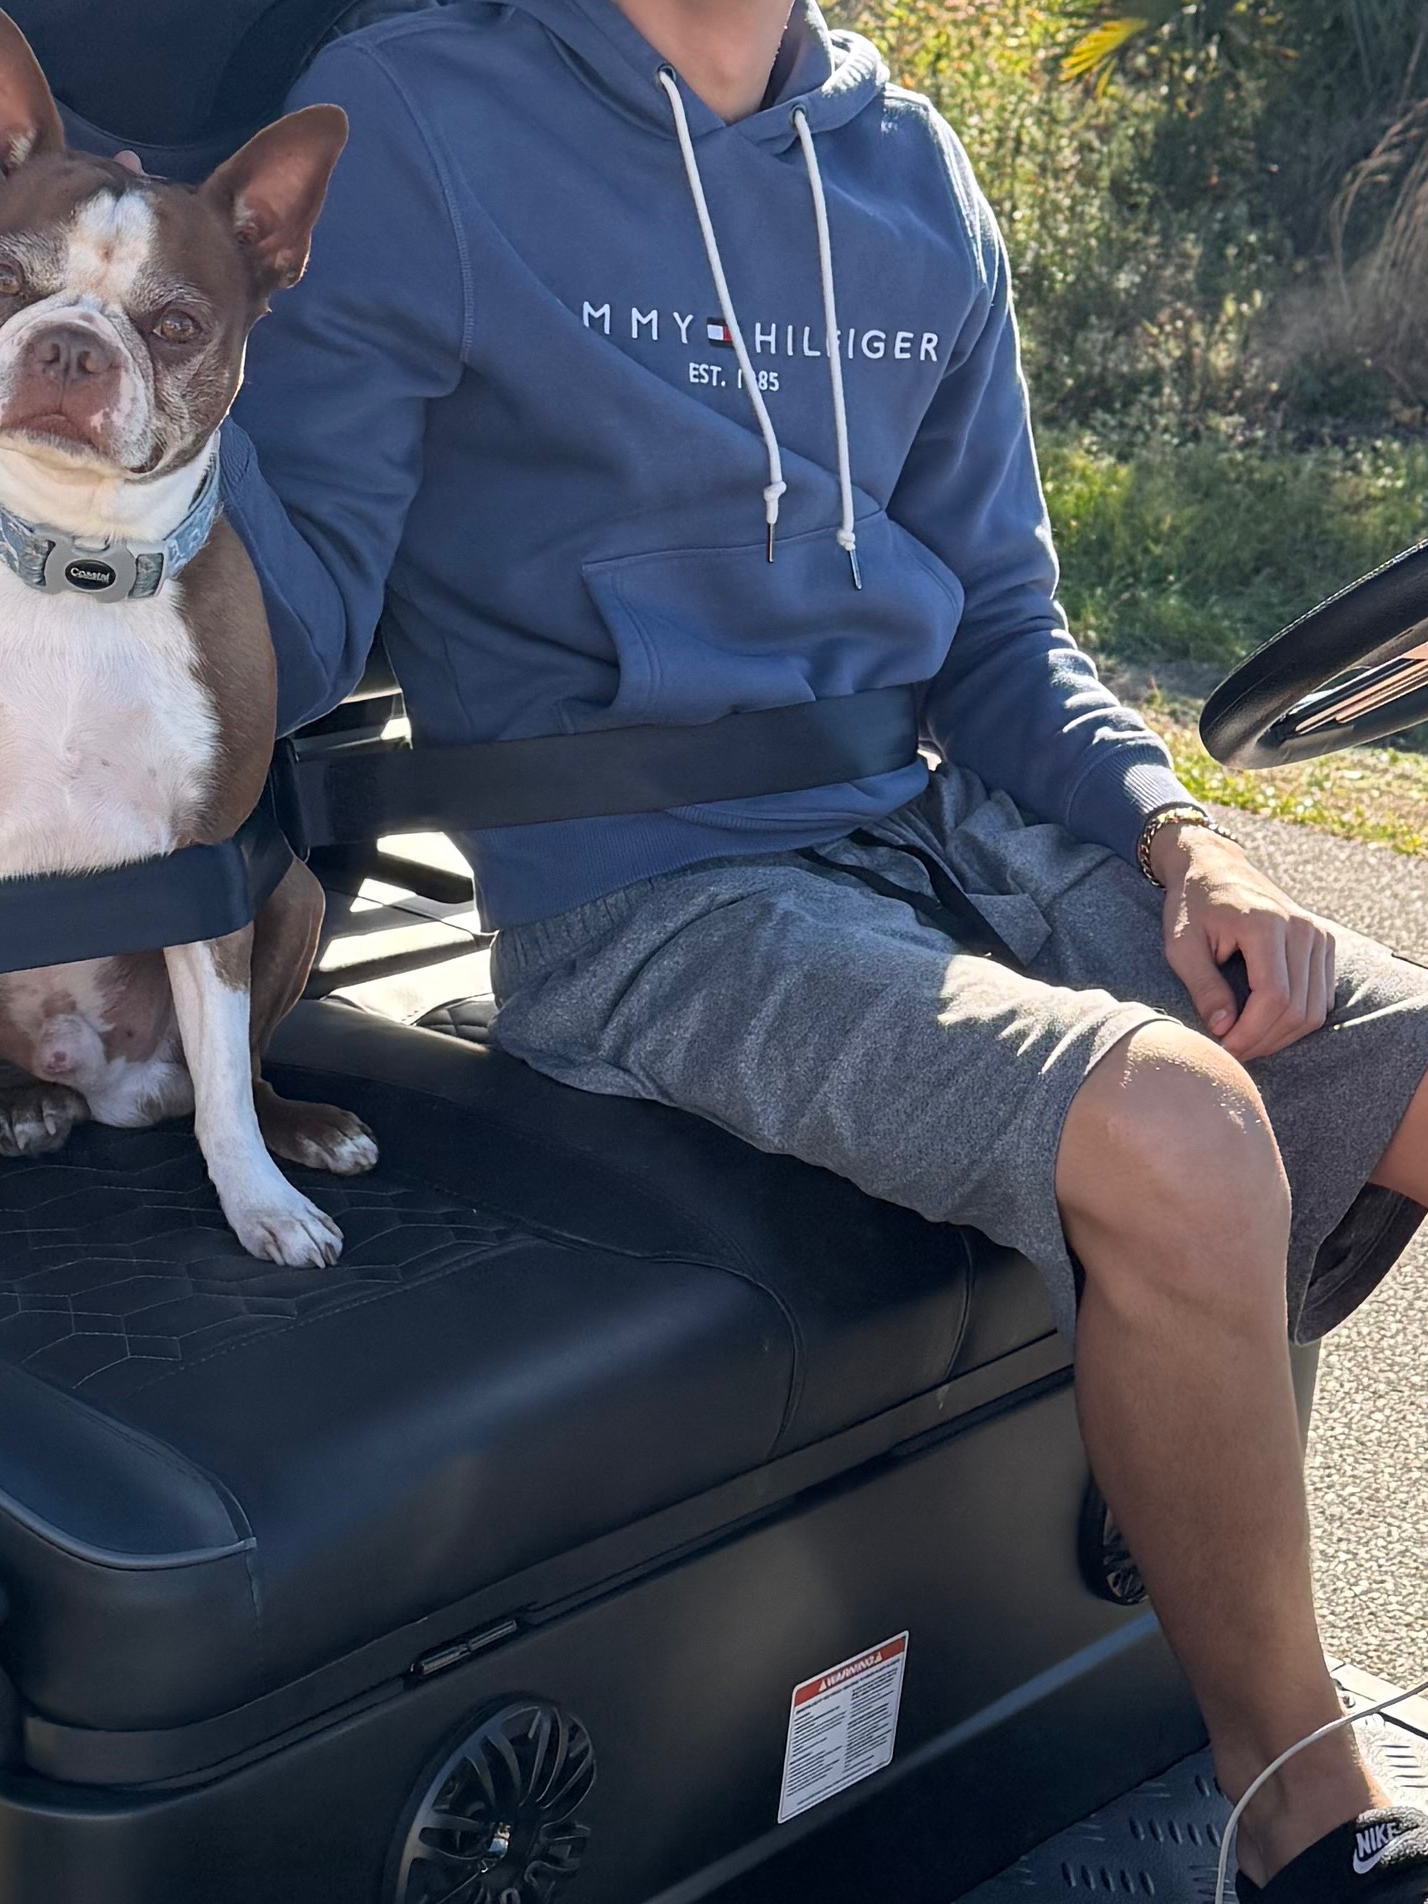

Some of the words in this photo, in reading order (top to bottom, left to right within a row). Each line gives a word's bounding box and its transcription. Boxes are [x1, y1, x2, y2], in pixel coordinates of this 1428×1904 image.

[583, 301, 693, 344] MMY
[755, 322, 938, 362] HILIGER
[689, 362, 726, 386] EST.
[737, 370, 780, 392] 185
[1355, 1822, 1400, 1858] NIKE
